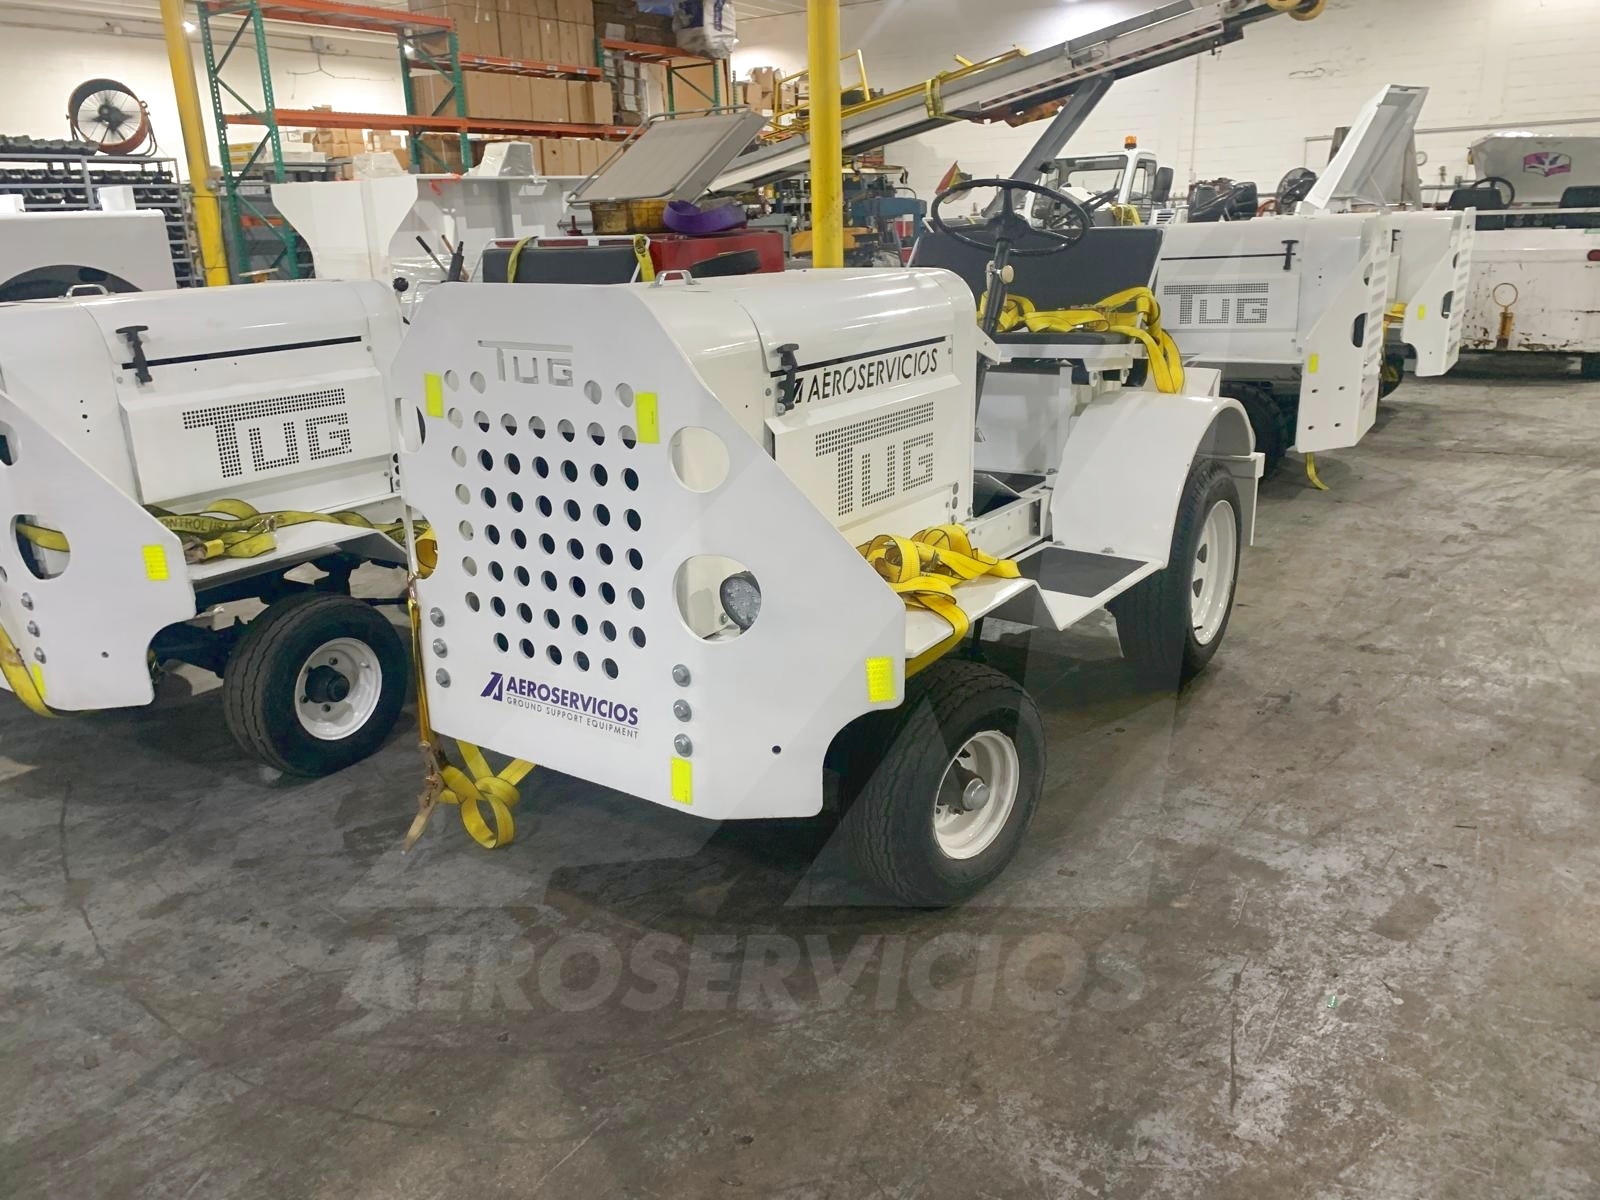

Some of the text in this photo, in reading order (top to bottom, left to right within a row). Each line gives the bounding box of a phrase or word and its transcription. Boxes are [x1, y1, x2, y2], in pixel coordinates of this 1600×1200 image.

[1163, 283, 1269, 324] TUG
[478, 340, 574, 387] TUG
[807, 347, 938, 403] AEROSERVICIOS
[182, 388, 353, 478] TUG
[815, 401, 934, 516] TUG
[506, 676, 639, 726] AEROSERVICIOS
[506, 696, 639, 740] GROUND SUPPORT EQUIPMENT
